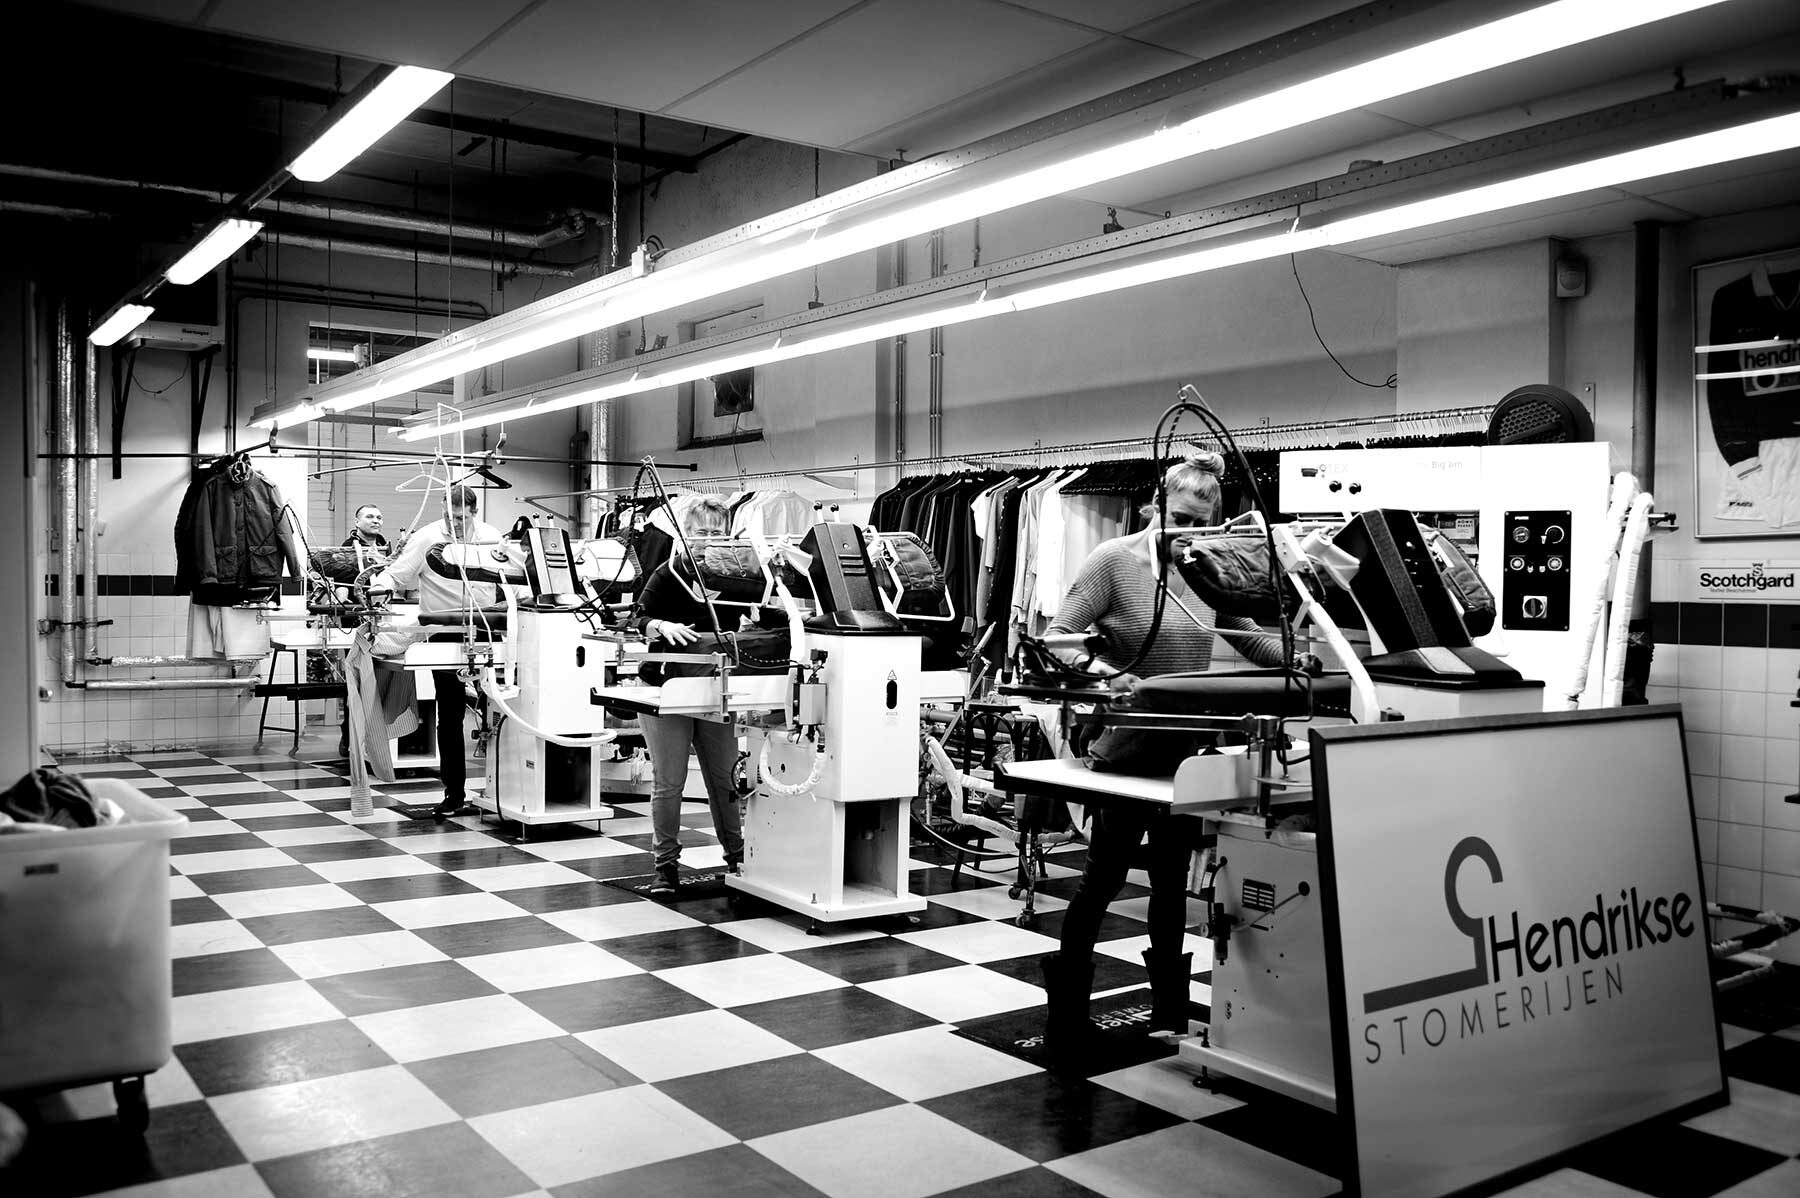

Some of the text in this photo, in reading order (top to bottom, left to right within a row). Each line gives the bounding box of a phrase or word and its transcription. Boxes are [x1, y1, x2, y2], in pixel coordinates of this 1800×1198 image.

[1700, 573, 1794, 591] Scotchgard
[1488, 886, 1695, 984] Hendrikse
[1364, 962, 1623, 1064] STOMERIJEN
